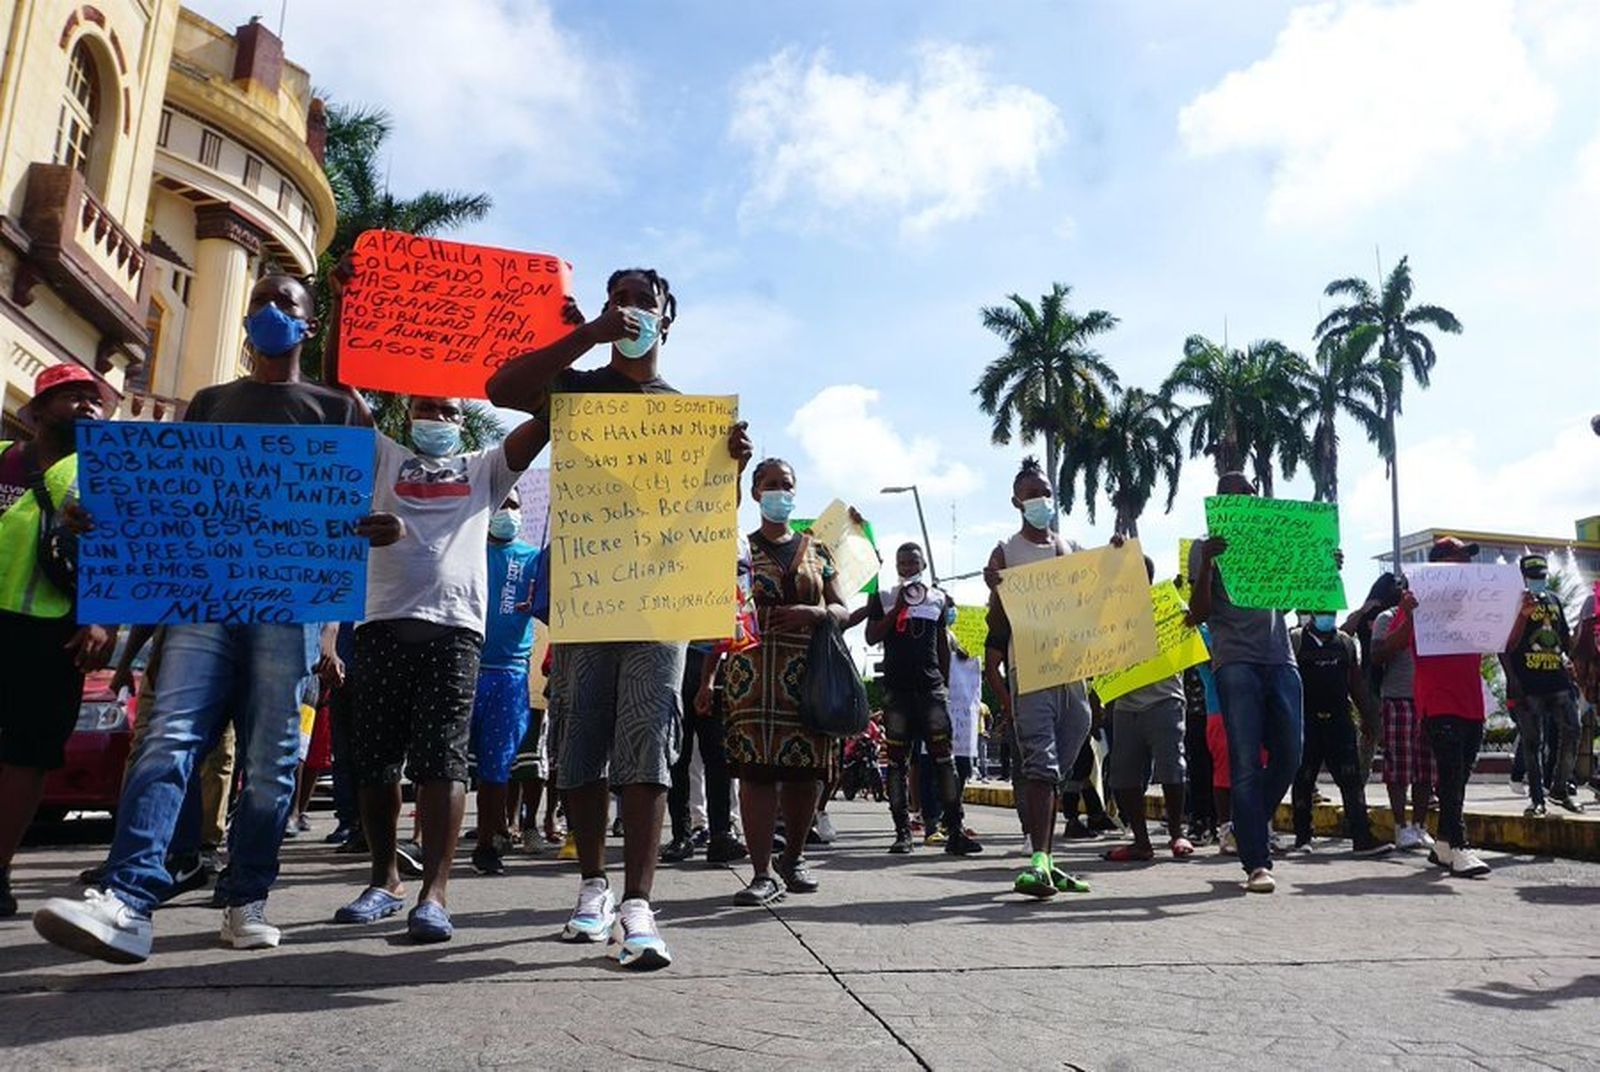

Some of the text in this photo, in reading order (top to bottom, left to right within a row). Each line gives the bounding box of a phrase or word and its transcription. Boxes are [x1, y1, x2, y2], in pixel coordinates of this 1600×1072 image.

[408, 280, 440, 293] DE
[505, 275, 554, 296] CON
[346, 336, 435, 360] CASOS
[443, 349, 474, 364] DE
[260, 433, 298, 457] ES
[306, 437, 340, 457] DE
[82, 449, 144, 474] 303
[192, 455, 227, 478] NO
[291, 461, 365, 484] TANTO
[88, 475, 203, 497] ESPACIO
[282, 480, 363, 507] TANTAS
[82, 540, 119, 560] UN
[81, 580, 120, 601] AL
[308, 586, 353, 605] DE
[155, 599, 296, 626] MEXICO
